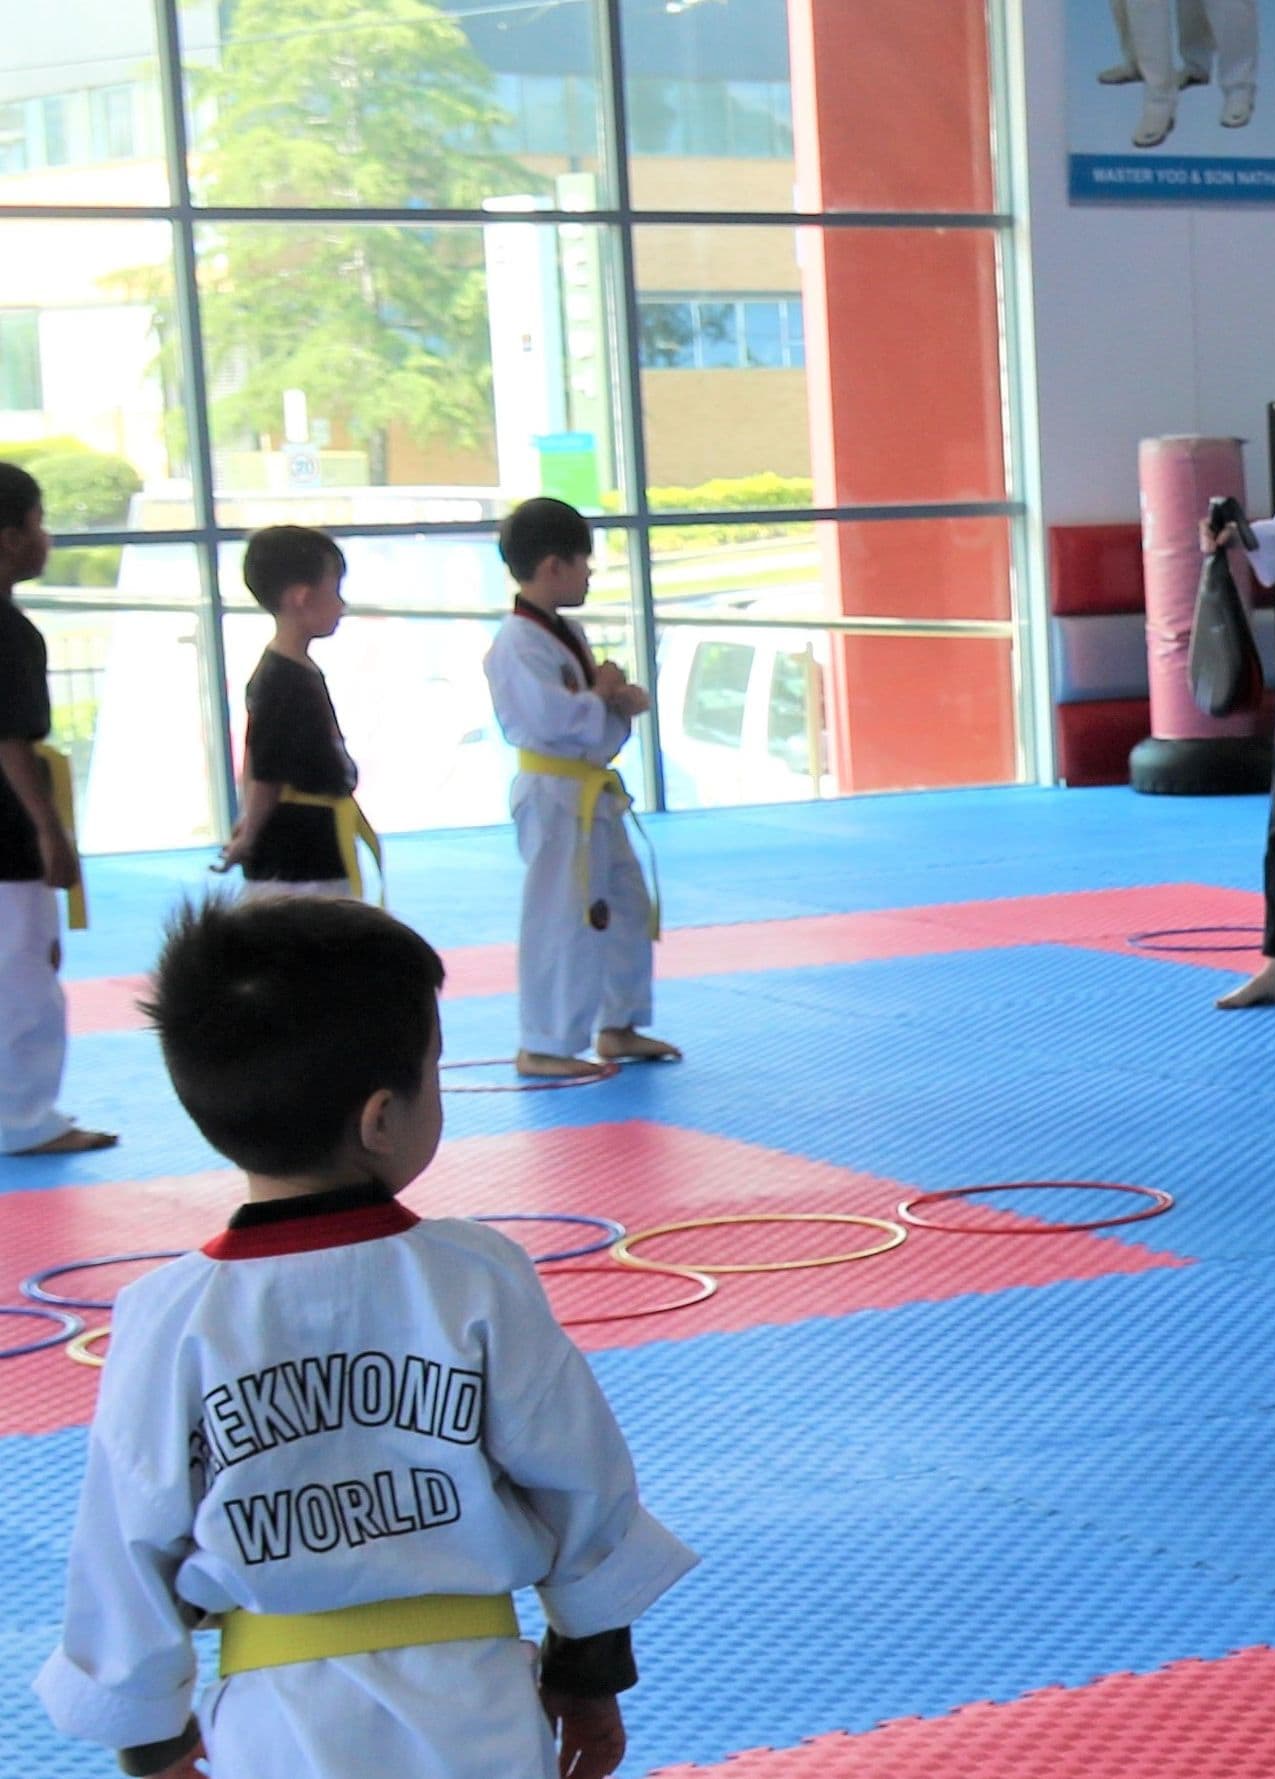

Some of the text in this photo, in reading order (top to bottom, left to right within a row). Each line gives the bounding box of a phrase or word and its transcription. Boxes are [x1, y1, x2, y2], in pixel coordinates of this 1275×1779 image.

[1092, 167, 1153, 184] MASTER
[1203, 170, 1235, 186] SON
[224, 1468, 461, 1565] WORLD
